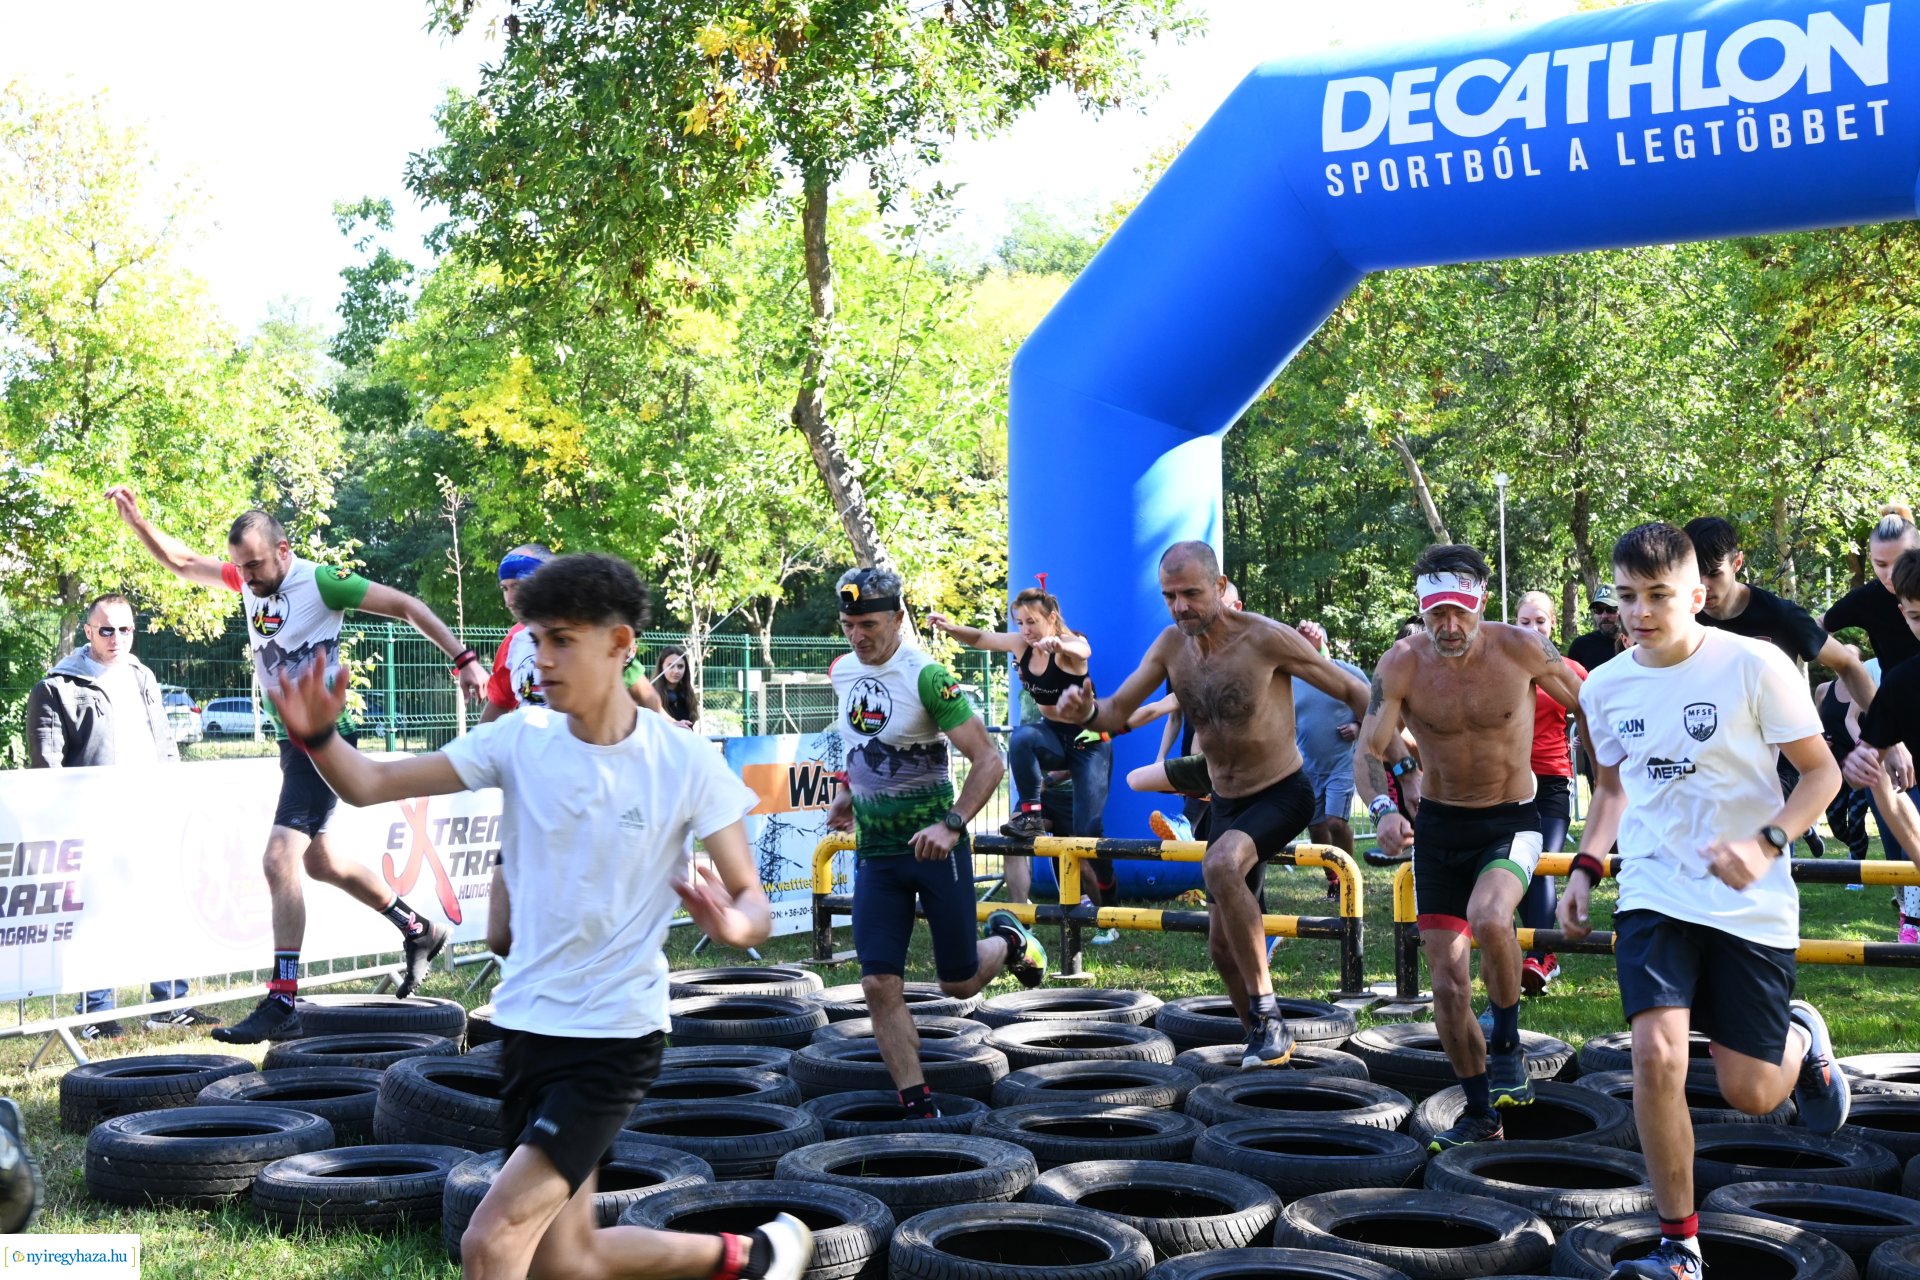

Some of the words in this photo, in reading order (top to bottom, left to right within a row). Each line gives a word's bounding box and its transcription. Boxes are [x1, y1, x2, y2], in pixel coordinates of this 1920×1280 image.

[1321, 2, 1891, 153] DECATHLON
[1325, 137, 1541, 197] SPORTBÓL
[1569, 137, 1589, 172] A
[1616, 99, 1889, 166] LEGTÖBBET
[1687, 708, 1713, 717] MFSE
[53, 921, 73, 942] SE
